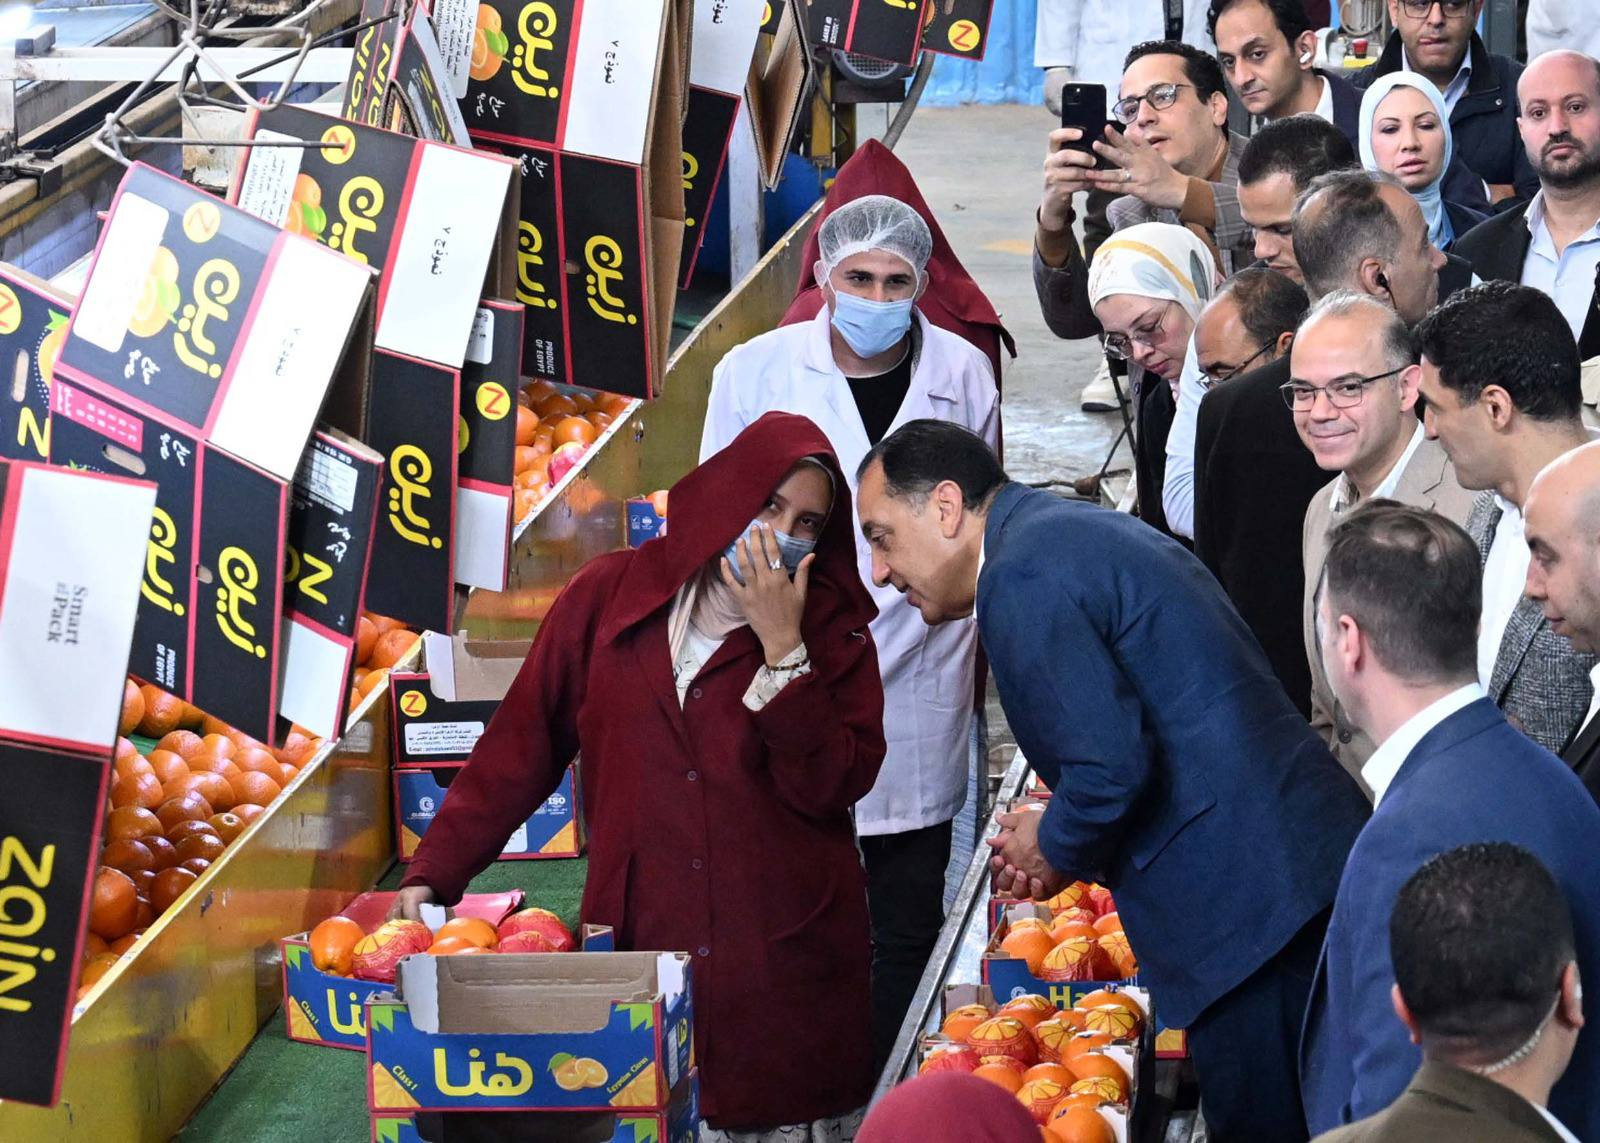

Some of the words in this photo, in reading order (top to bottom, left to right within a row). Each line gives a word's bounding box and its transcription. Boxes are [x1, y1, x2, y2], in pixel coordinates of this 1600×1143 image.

[511, 2, 558, 98] زين
[584, 235, 637, 325] زين
[174, 259, 240, 378] زين
[535, 338, 544, 350] OF
[543, 340, 556, 375] PRODUCE
[536, 350, 545, 375] EGYPT
[389, 444, 443, 549] زين
[65, 584, 88, 645] Smart
[216, 546, 266, 659] زين
[156, 643, 166, 656] OF
[155, 656, 165, 684] EGYPT
[166, 648, 176, 688] PRODUCE
[405, 693, 421, 713] Z
[547, 797, 566, 806] ISO
[300, 1000, 315, 1021] Class
[327, 988, 367, 1037] نا
[1050, 986, 1085, 1009] Ha
[392, 1065, 414, 1087] Class
[433, 1048, 533, 1096] هنا
